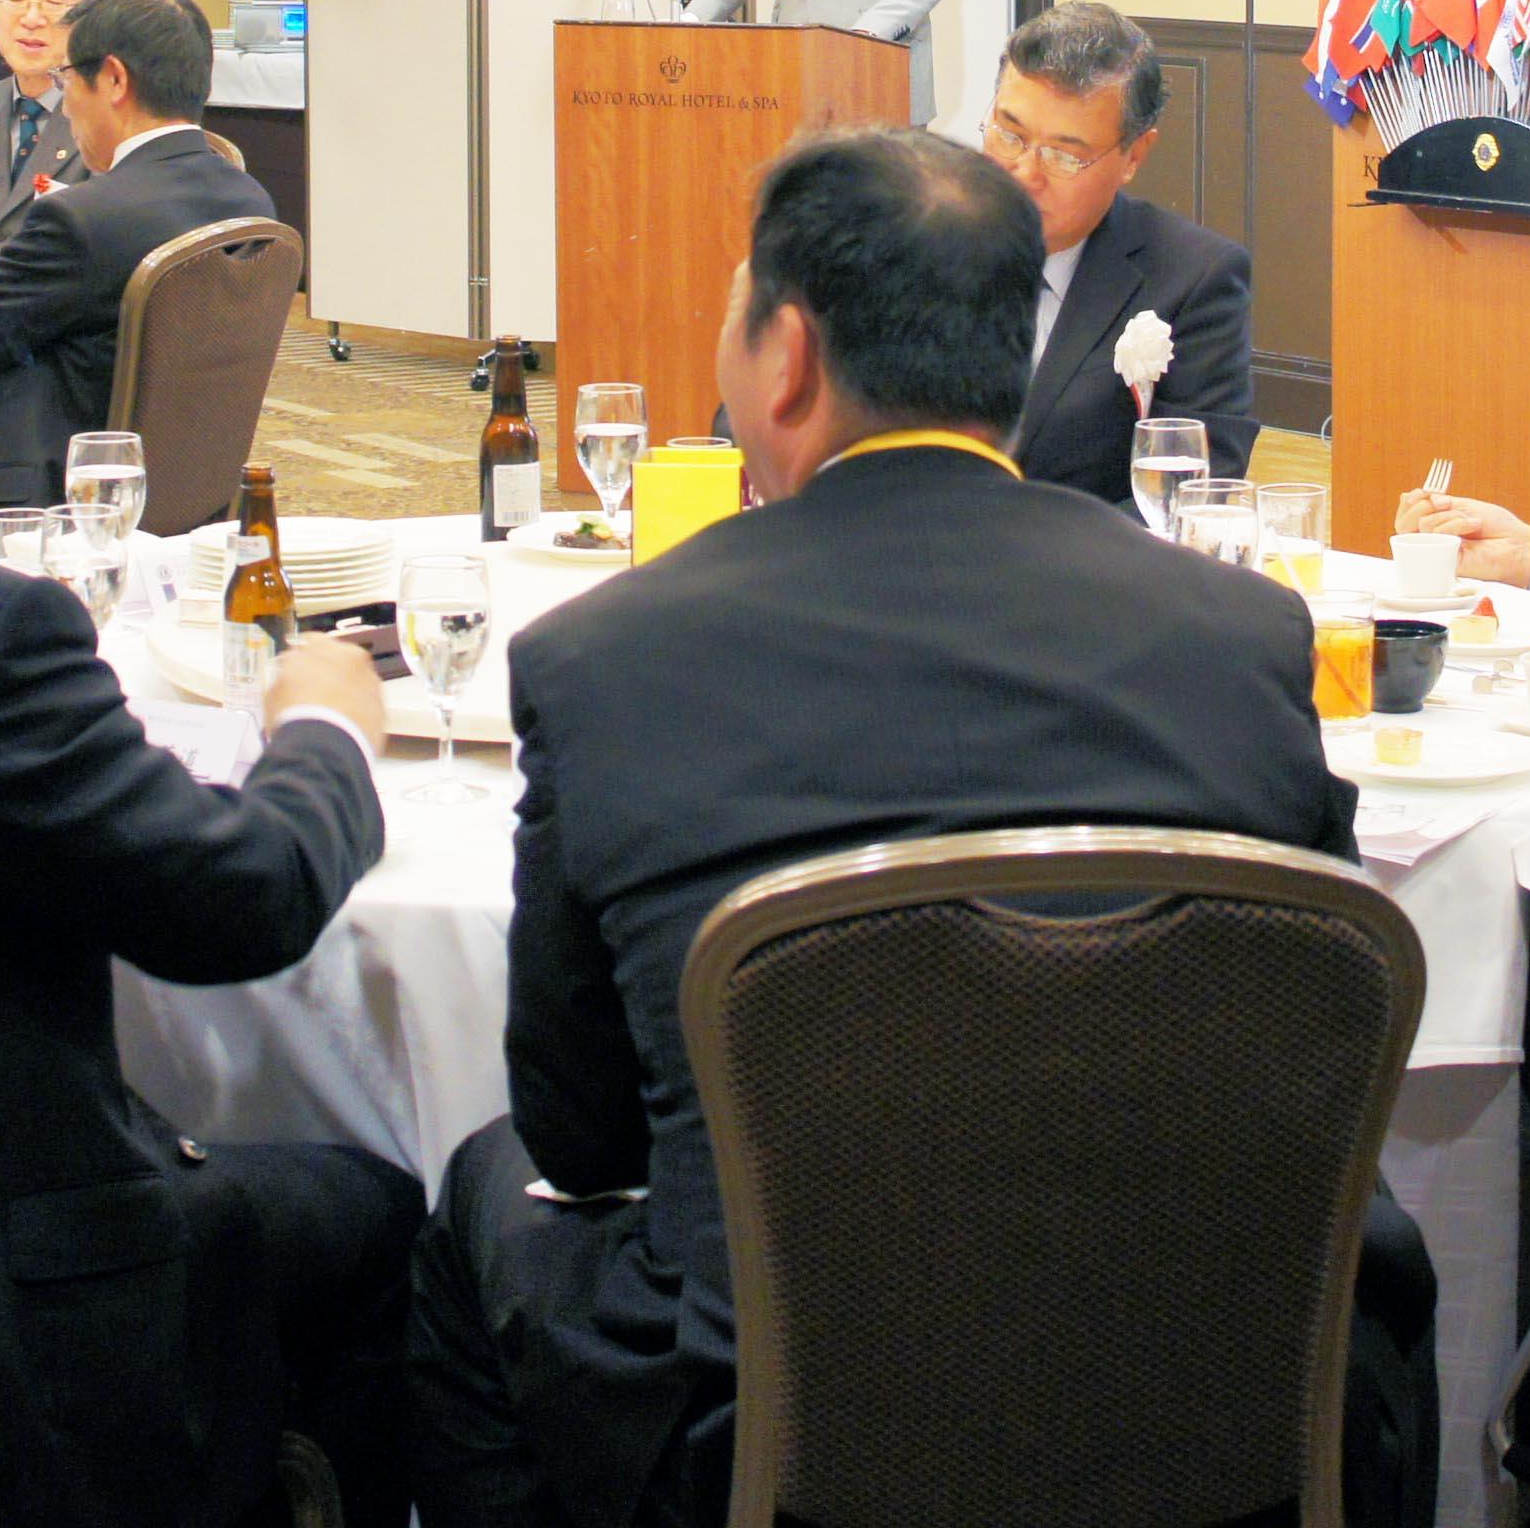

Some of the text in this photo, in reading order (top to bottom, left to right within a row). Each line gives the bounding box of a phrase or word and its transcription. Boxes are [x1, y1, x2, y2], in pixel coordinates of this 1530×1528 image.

[573, 89, 780, 110] KYOTO ROYAL HOTEL & SPA
